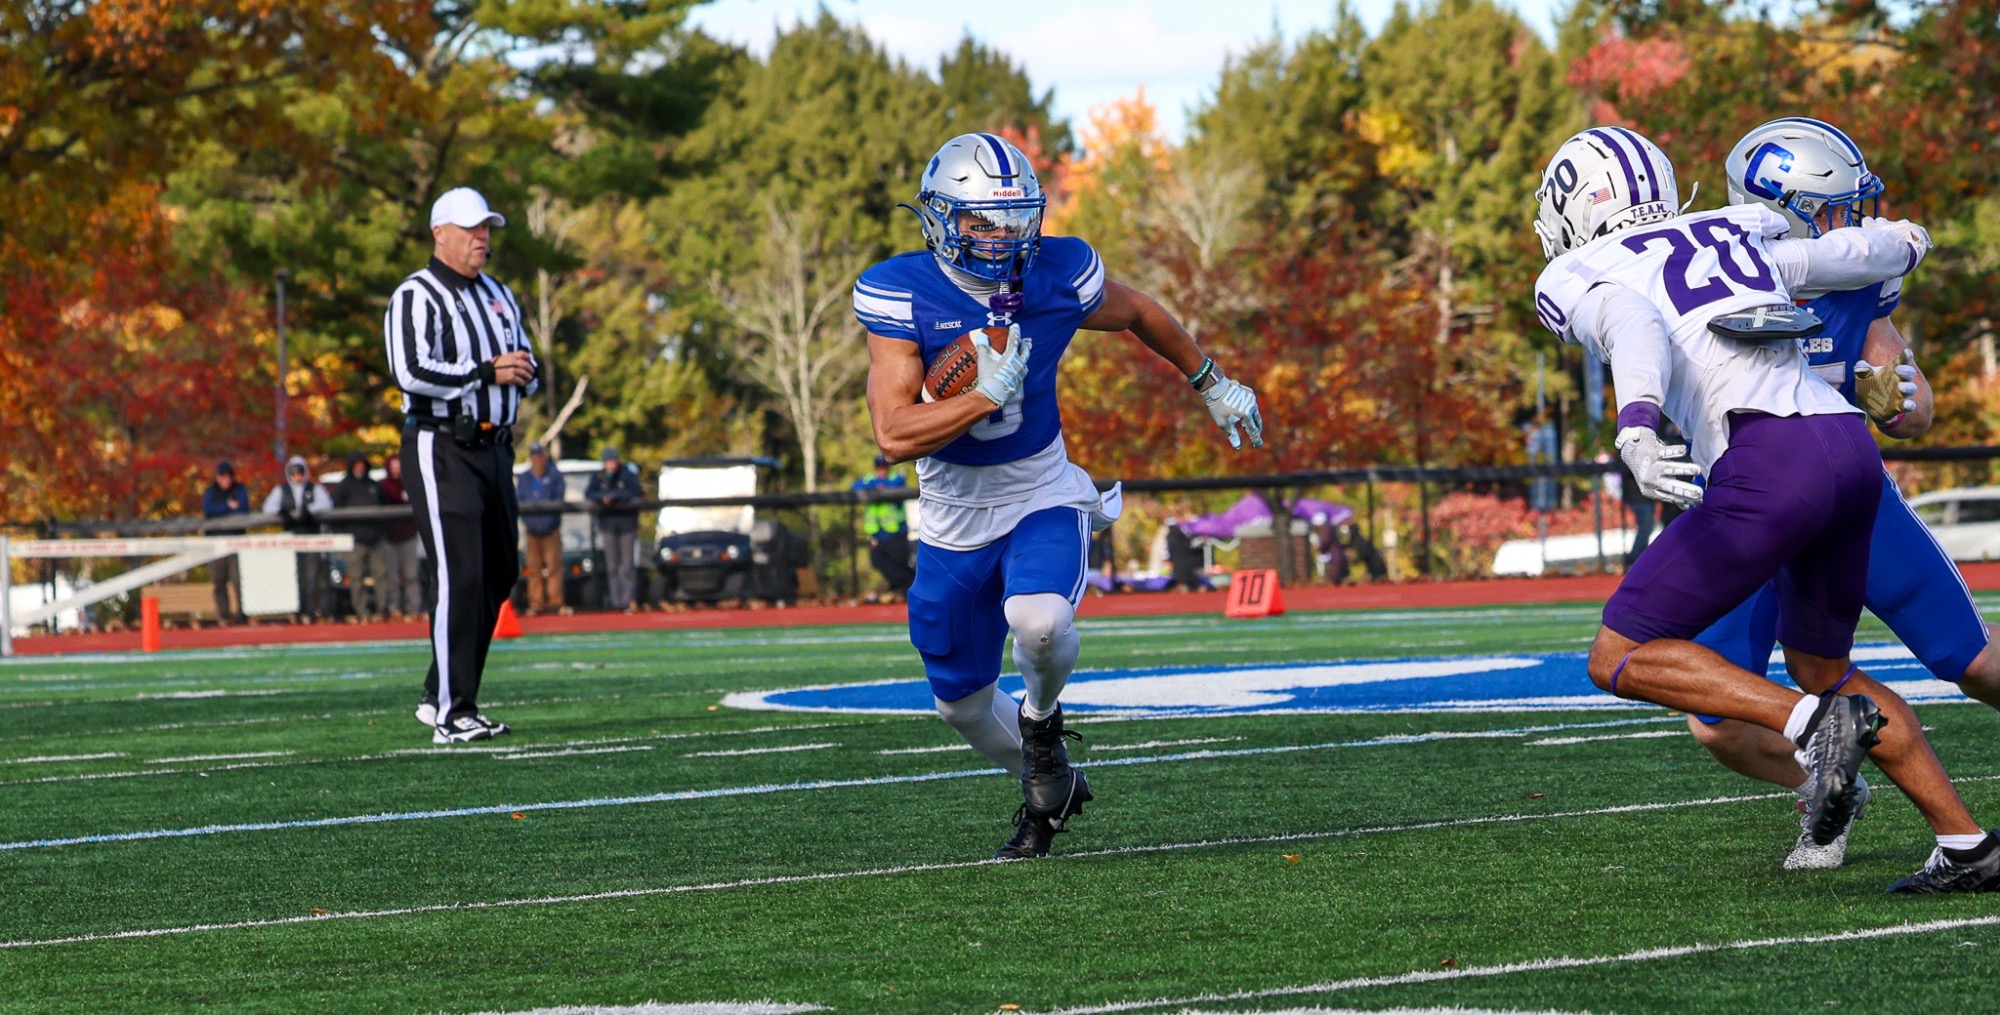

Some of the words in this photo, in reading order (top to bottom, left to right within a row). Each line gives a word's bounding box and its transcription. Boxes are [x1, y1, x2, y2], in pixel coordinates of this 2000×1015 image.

[1543, 158, 1578, 216] 20
[1630, 203, 1667, 219] T.E.A.M.
[1620, 217, 1777, 316] 20
[504, 328, 513, 344] R
[939, 320, 962, 330] NESCAC
[1239, 574, 1265, 605] 10
